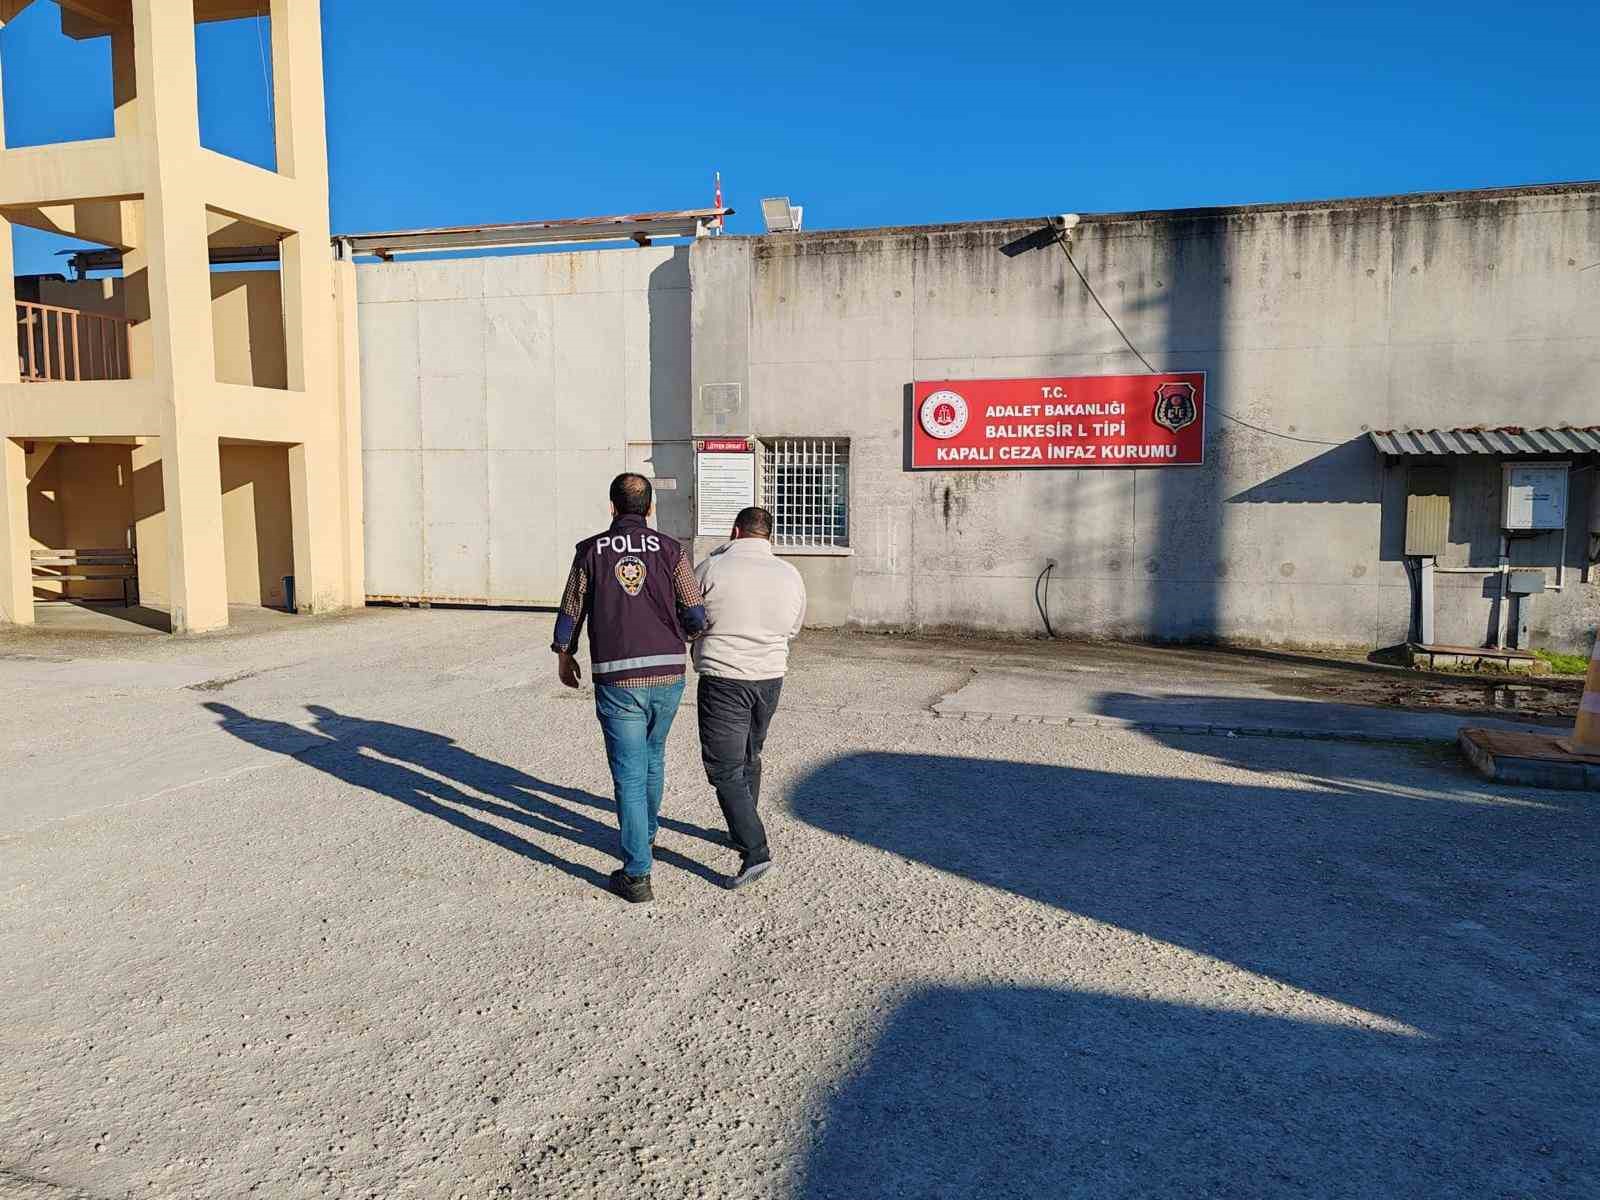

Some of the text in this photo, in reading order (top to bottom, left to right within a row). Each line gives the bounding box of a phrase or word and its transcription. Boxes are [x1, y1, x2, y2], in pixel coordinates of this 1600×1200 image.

[1041, 386, 1068, 398] T.C.
[985, 401, 1126, 417] ADALET BAKANLIĞI
[985, 420, 1126, 438] BALIKESİR L TİPİ
[937, 443, 1177, 460] KAPALI CEZA İNFAZ KURUMU
